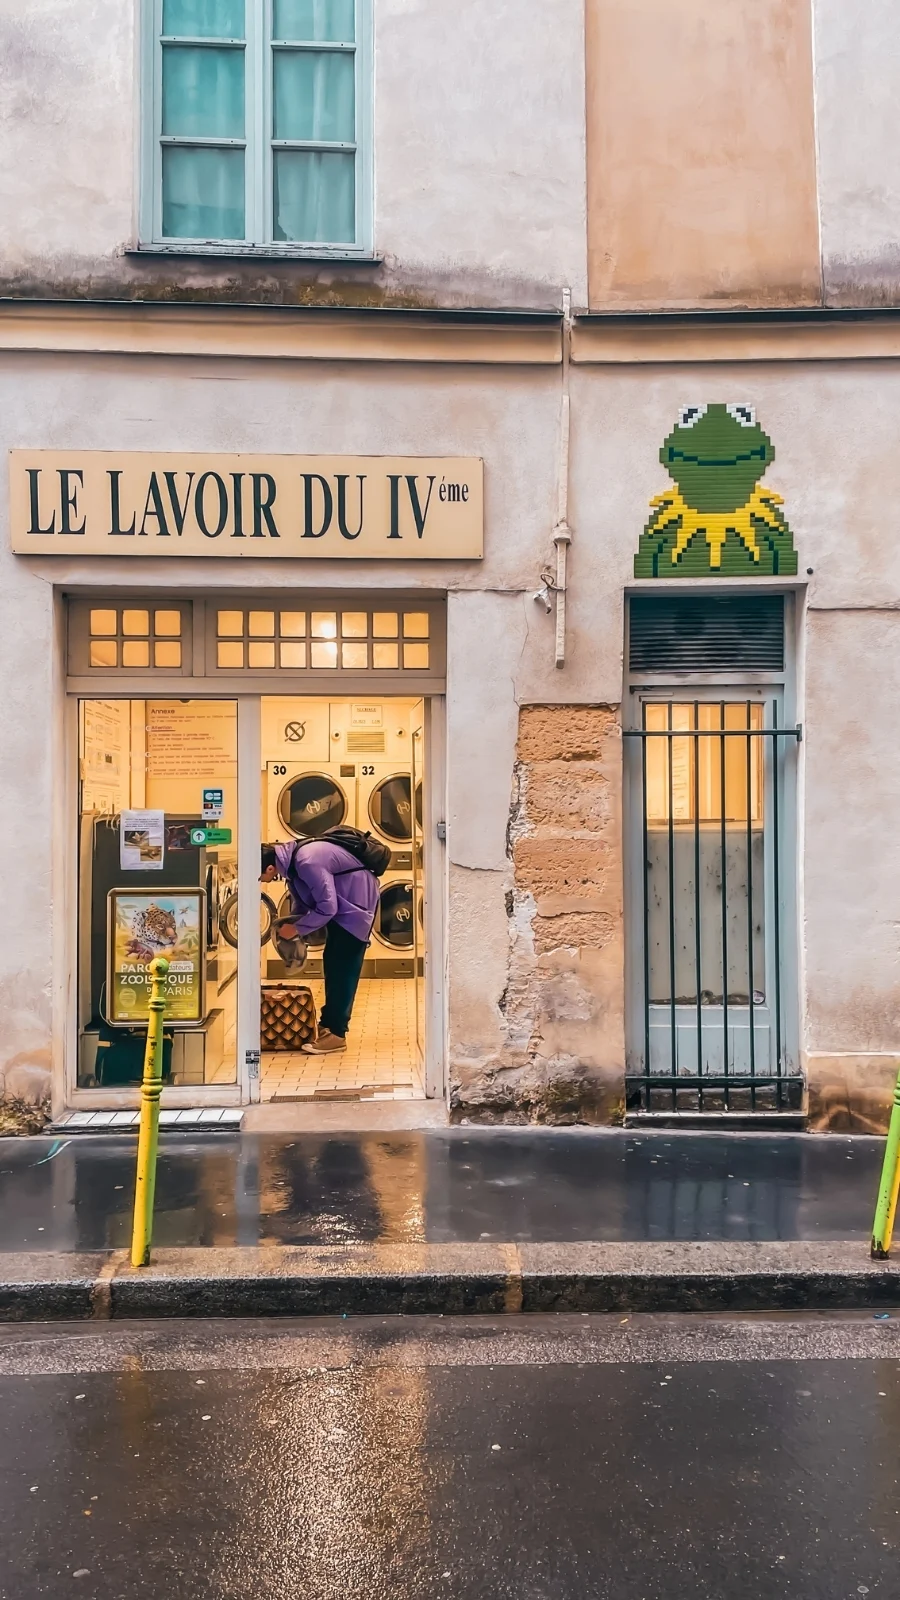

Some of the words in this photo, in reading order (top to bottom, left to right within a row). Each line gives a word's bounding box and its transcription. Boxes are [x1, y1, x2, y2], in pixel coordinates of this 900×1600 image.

[26, 469, 86, 535] LE
[106, 471, 281, 538] LAVOIR
[300, 474, 367, 540] DU
[273, 765, 287, 776] 30
[361, 765, 375, 776] 32
